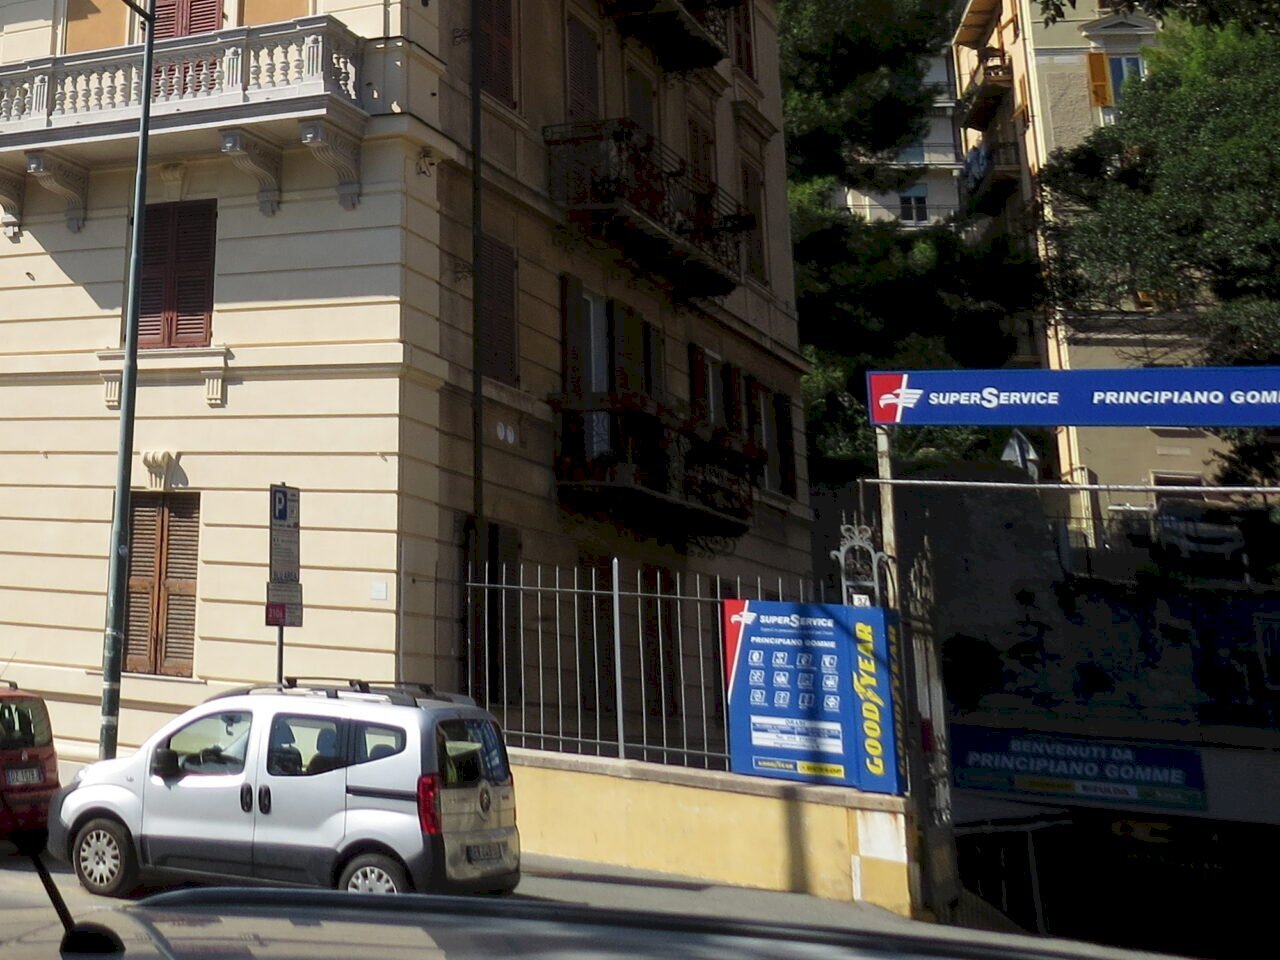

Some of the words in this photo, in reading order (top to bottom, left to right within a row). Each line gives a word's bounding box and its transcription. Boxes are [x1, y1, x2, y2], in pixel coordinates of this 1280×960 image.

[928, 386, 1060, 409] SUPERSERVICE
[1092, 390, 1224, 404] PRINCIPIANO
[1230, 390, 1280, 404] GOM
[759, 613, 835, 628] SUPERSERVICE
[750, 636, 803, 647] PRINCIPIANO
[852, 622, 886, 777] GOODYEAR
[1009, 737, 1109, 760] BENVENUTI
[1110, 746, 1135, 761] DA
[965, 750, 1100, 777] PRINCIPIANO
[1104, 763, 1186, 784] GOMME
